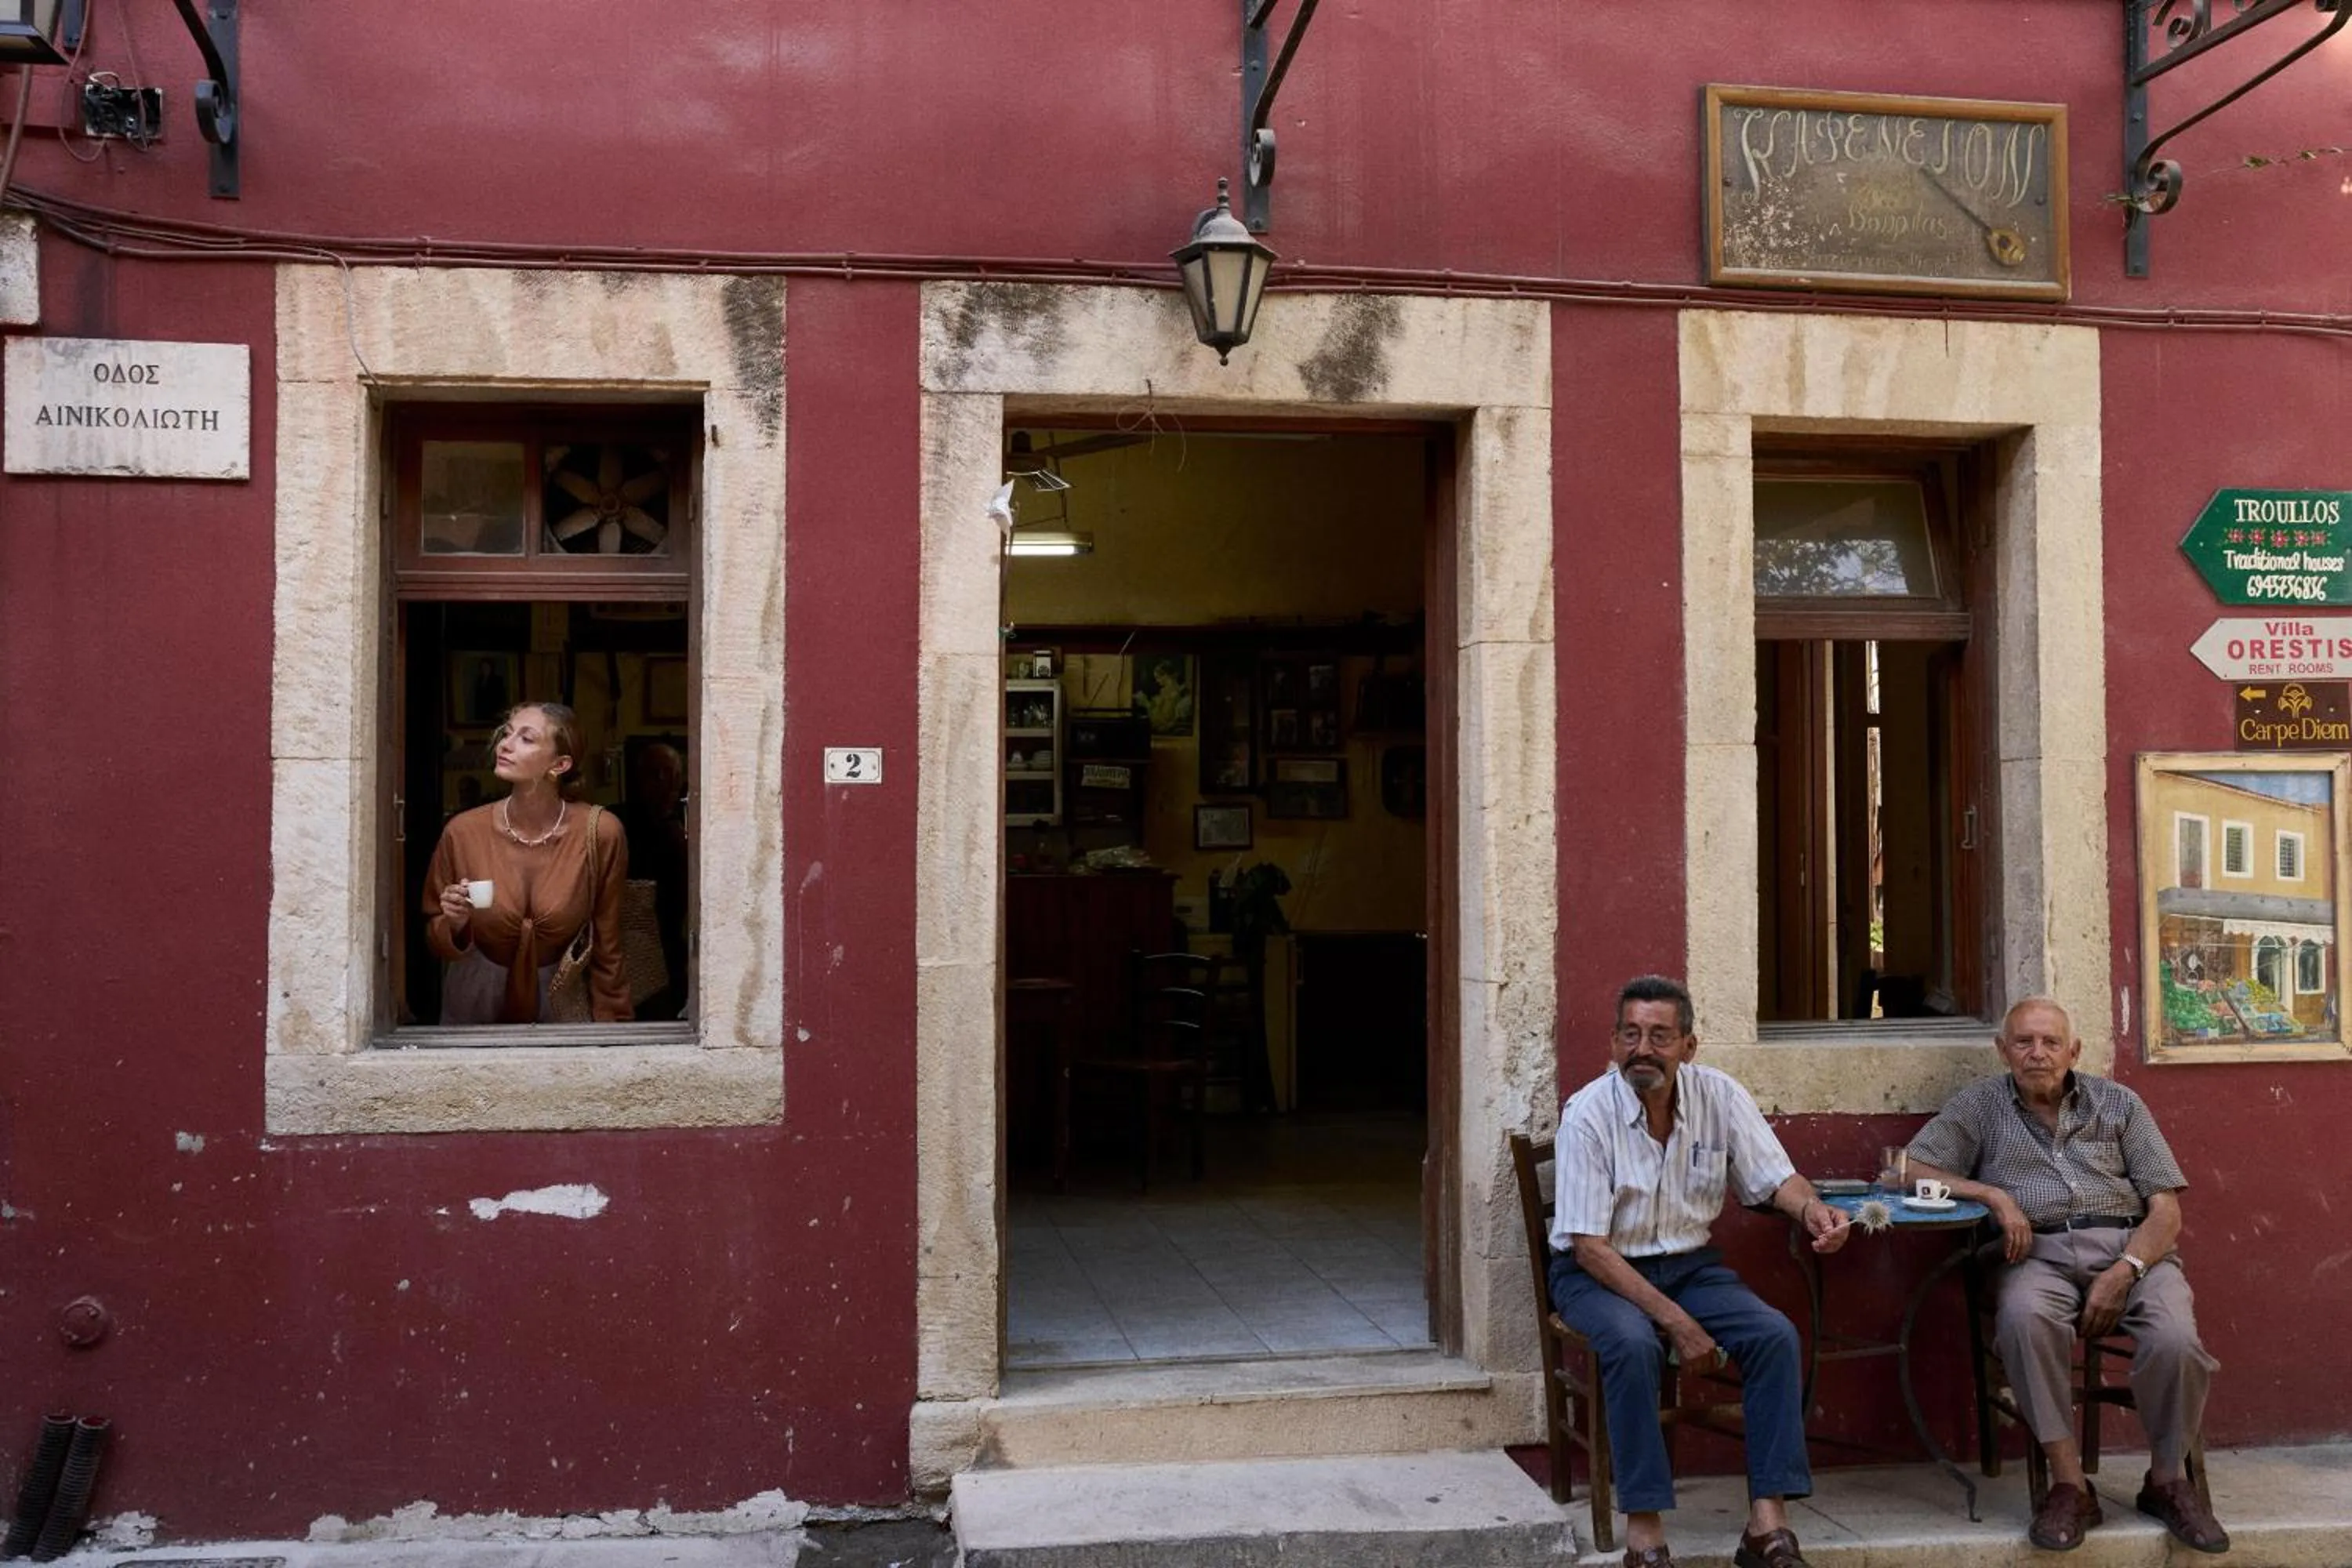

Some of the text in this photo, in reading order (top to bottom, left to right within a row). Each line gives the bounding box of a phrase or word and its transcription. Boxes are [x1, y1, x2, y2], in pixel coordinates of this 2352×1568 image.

[93, 363, 160, 385] ΟΔΟΣ
[2234, 499, 2340, 525] TROULLOS
[2223, 547, 2345, 572] Traditional houses
[2265, 622, 2314, 637] Villa
[2227, 638, 2352, 659] ORESTIS
[2249, 662, 2334, 675] RENT ROOMS
[2240, 718, 2350, 748] Carpe Diem
[846, 753, 862, 779] 2
